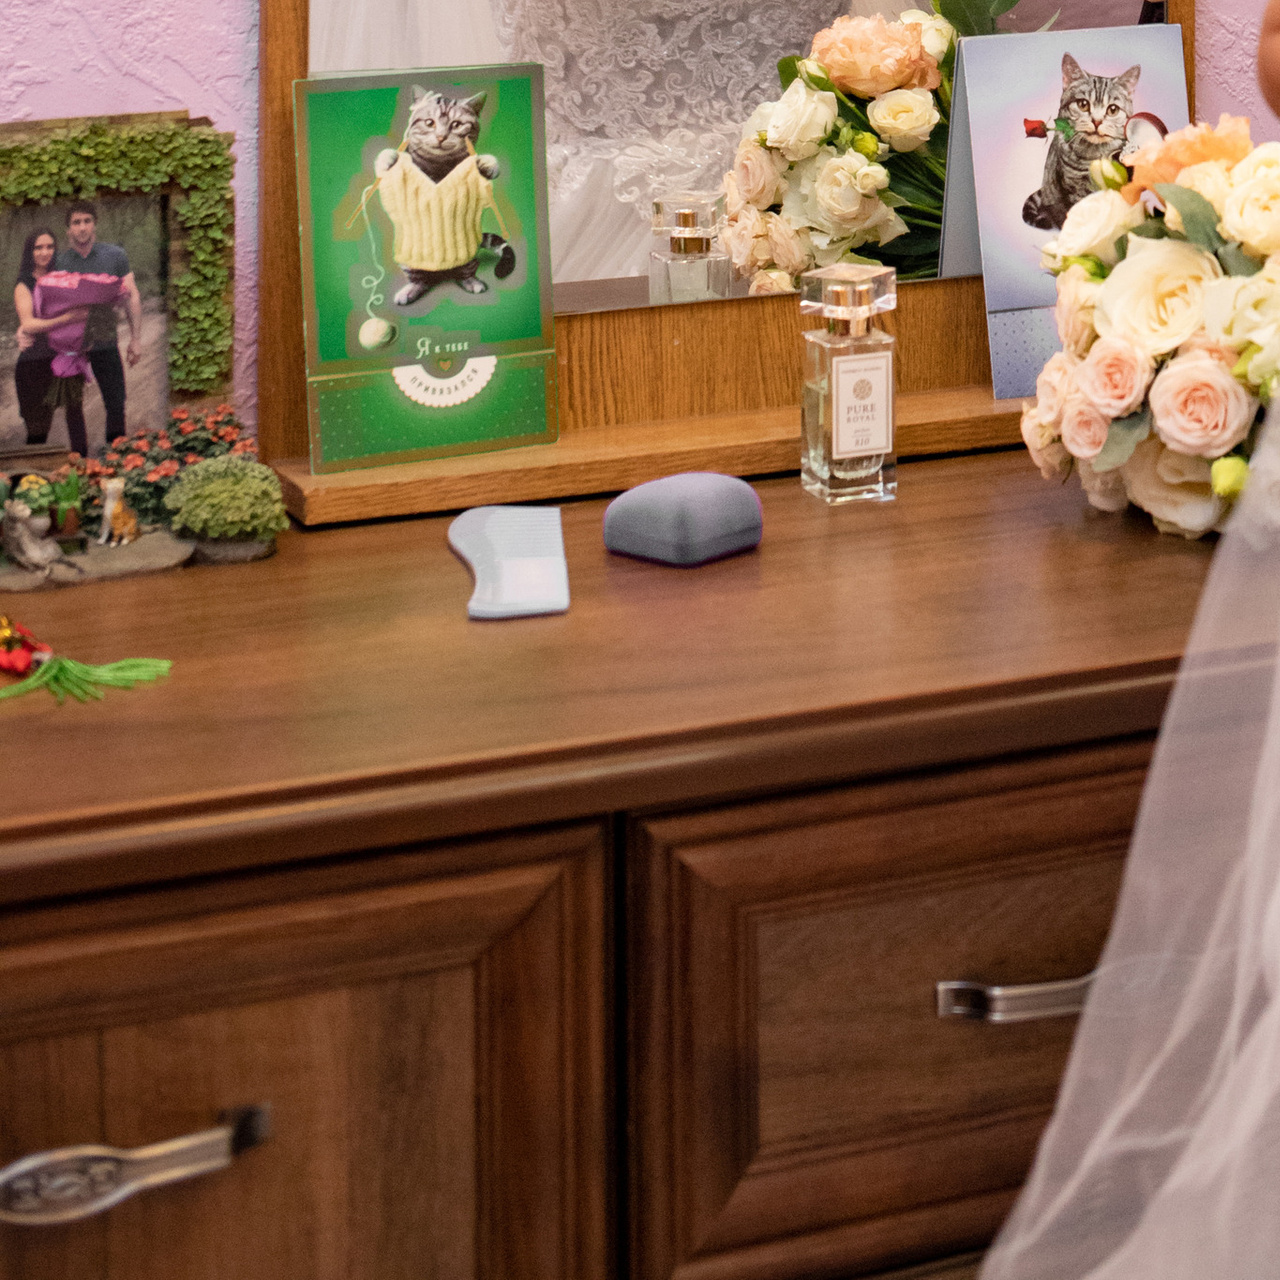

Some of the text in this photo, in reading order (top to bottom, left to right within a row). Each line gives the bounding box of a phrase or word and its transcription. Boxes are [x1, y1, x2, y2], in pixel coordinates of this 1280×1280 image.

[415, 337, 431, 359] Я
[410, 368, 478, 395] ПРИВЯЗАЛСЯ
[846, 404, 876, 415] PURE
[846, 414, 875, 424] ROYAL
